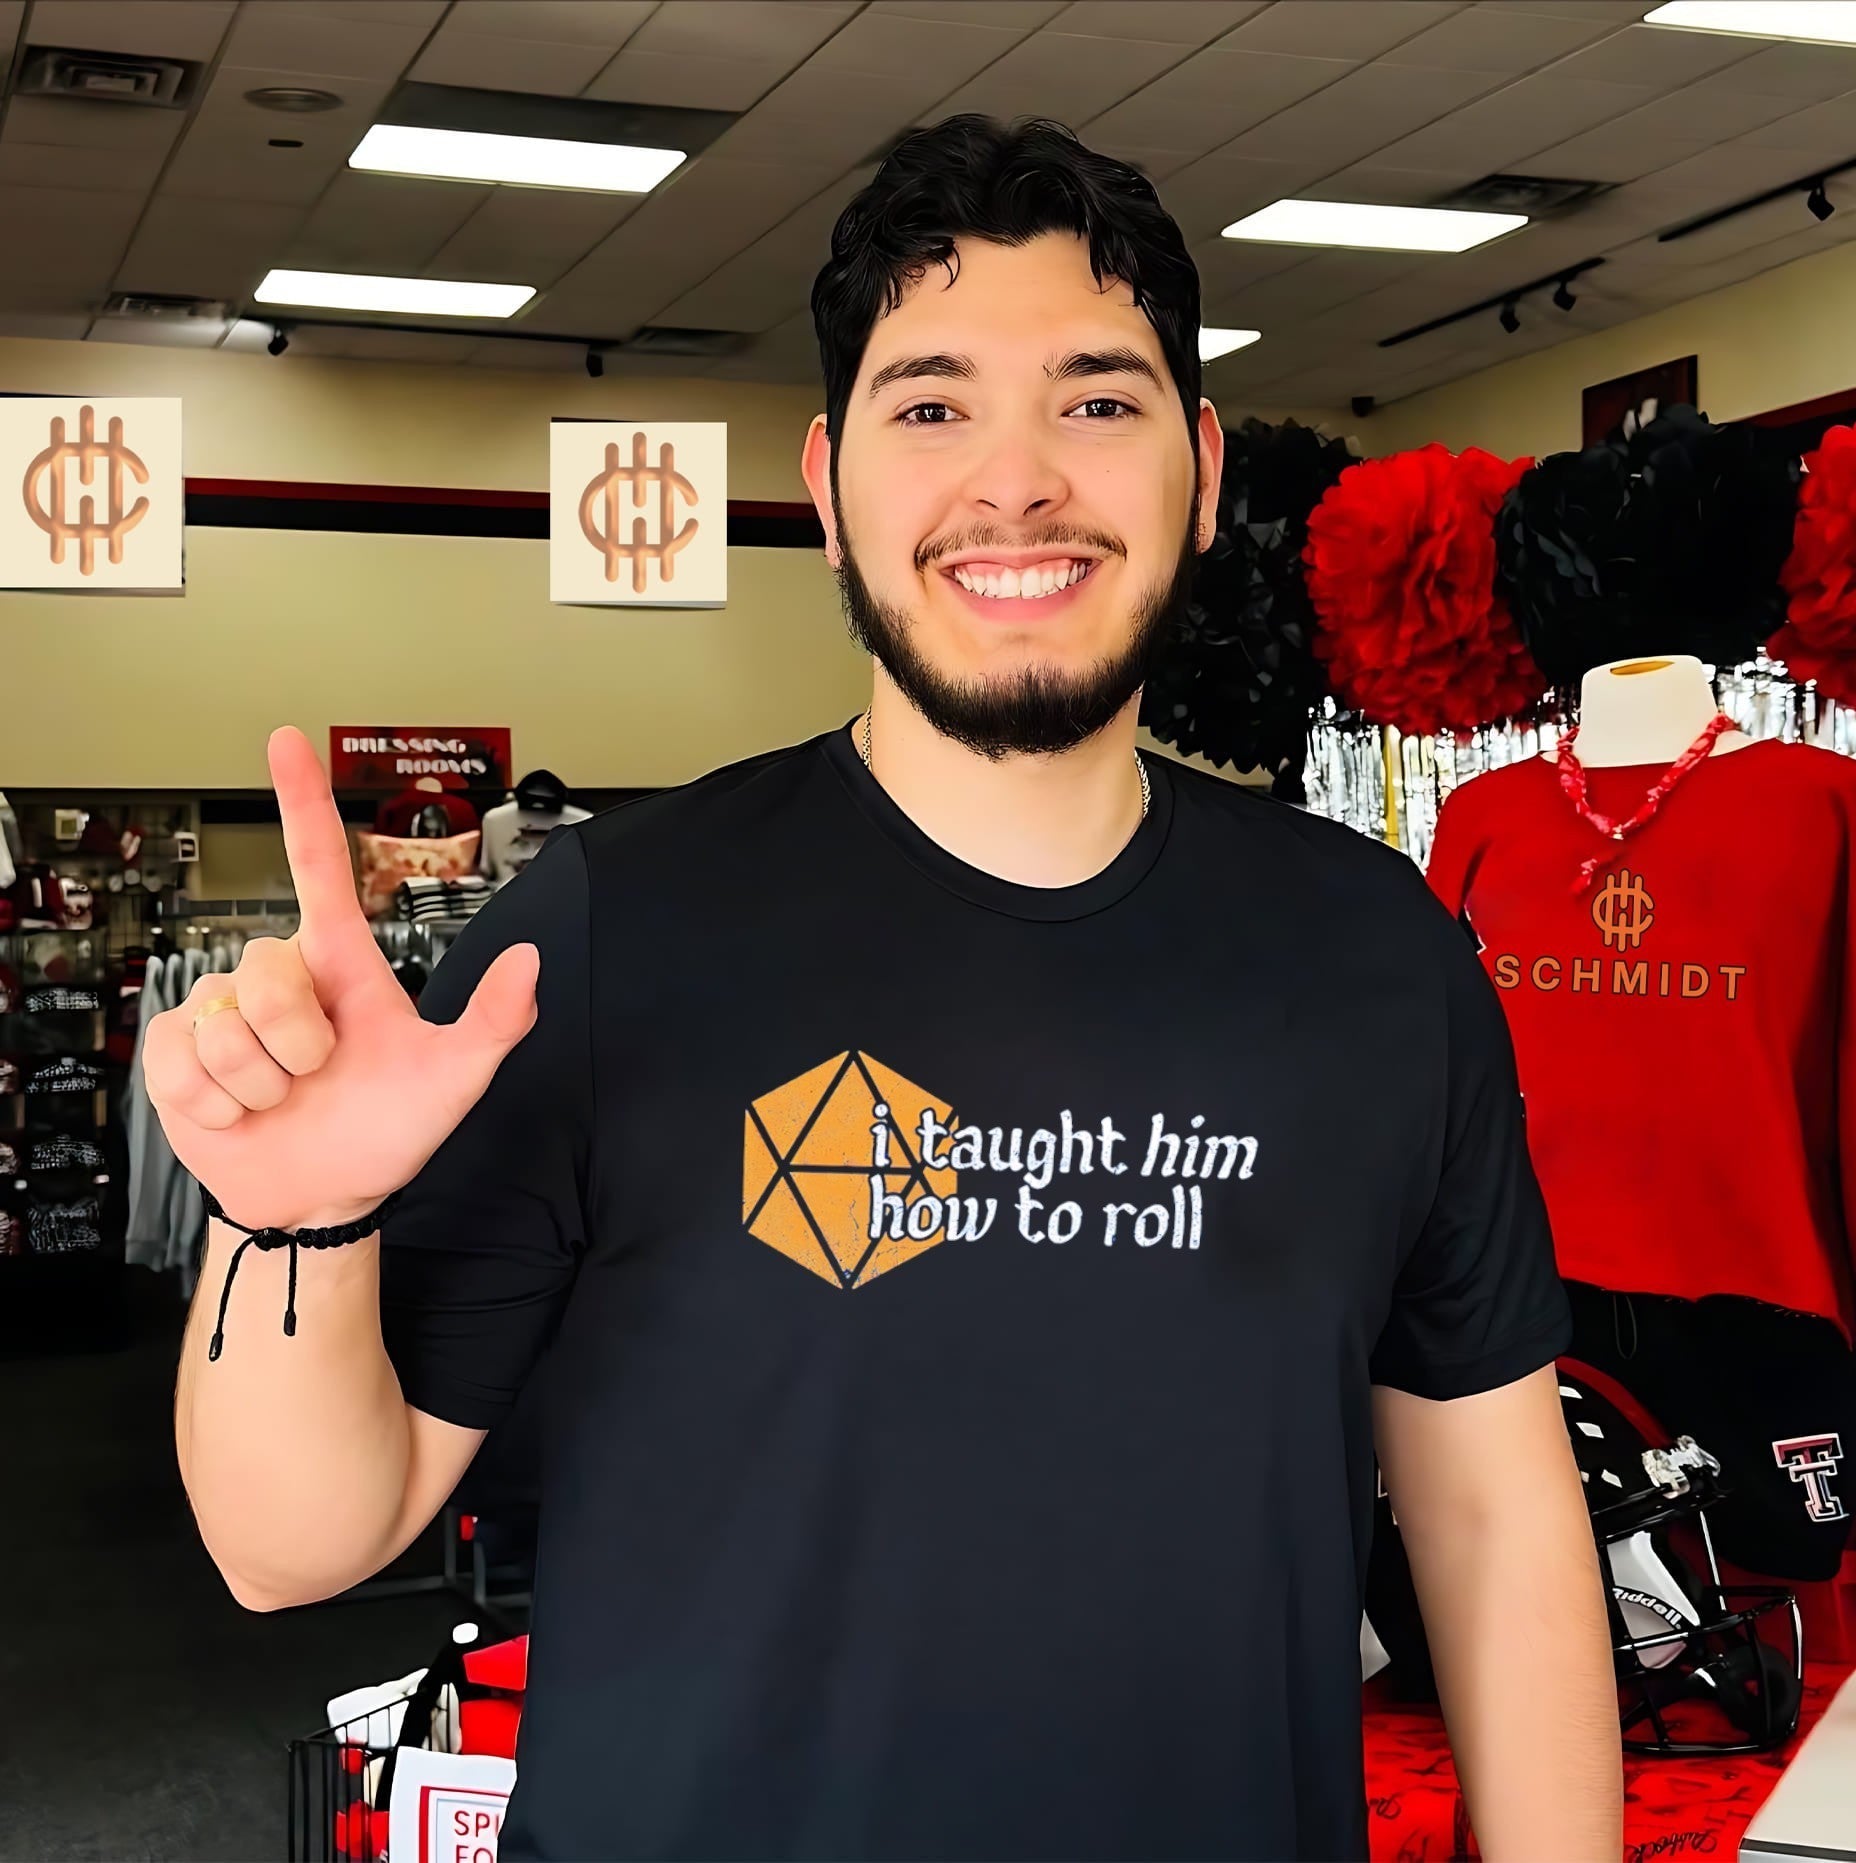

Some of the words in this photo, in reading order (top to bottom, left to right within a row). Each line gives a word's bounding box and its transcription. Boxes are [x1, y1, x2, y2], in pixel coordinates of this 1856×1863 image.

[342, 737, 467, 754] DRESSING
[396, 758, 487, 775] ROOMS
[1494, 954, 1747, 1000] SCHMIDT
[871, 1104, 891, 1168] i
[918, 1109, 1128, 1189] taught
[1140, 1112, 1259, 1179] him
[869, 1174, 998, 1242] how
[1015, 1184, 1083, 1244] to
[1102, 1184, 1203, 1250] roll
